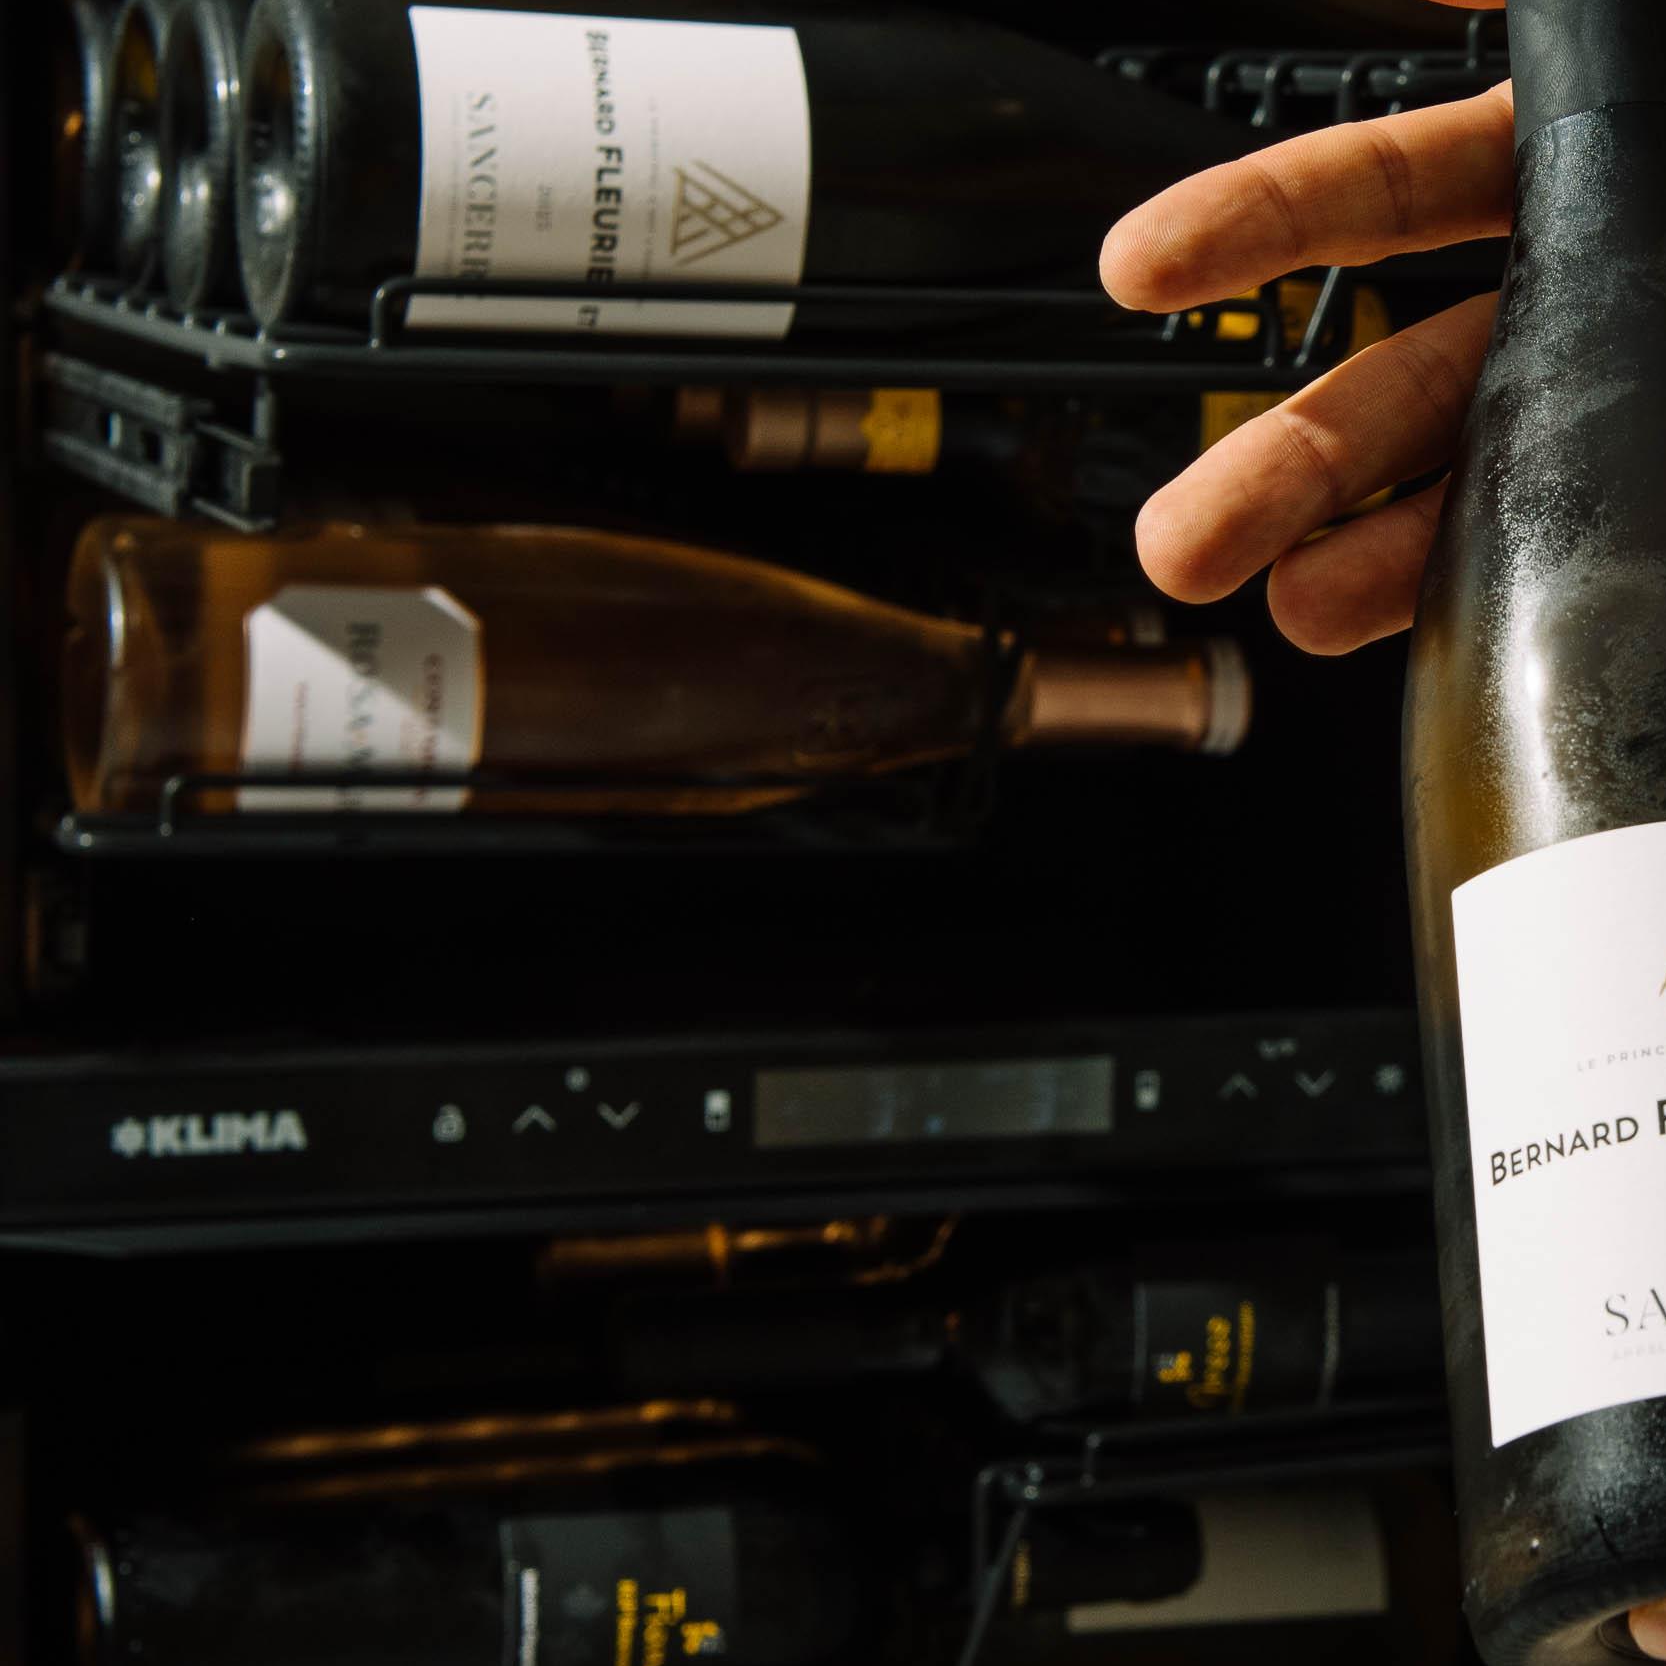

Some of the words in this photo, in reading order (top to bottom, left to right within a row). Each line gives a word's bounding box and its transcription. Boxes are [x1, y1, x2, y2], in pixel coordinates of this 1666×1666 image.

[461, 92, 497, 286] SANCERR
[586, 145, 624, 286] FLEURIE
[149, 1110, 307, 1157] KLIMA
[1489, 1116, 1640, 1186] BERNARD
